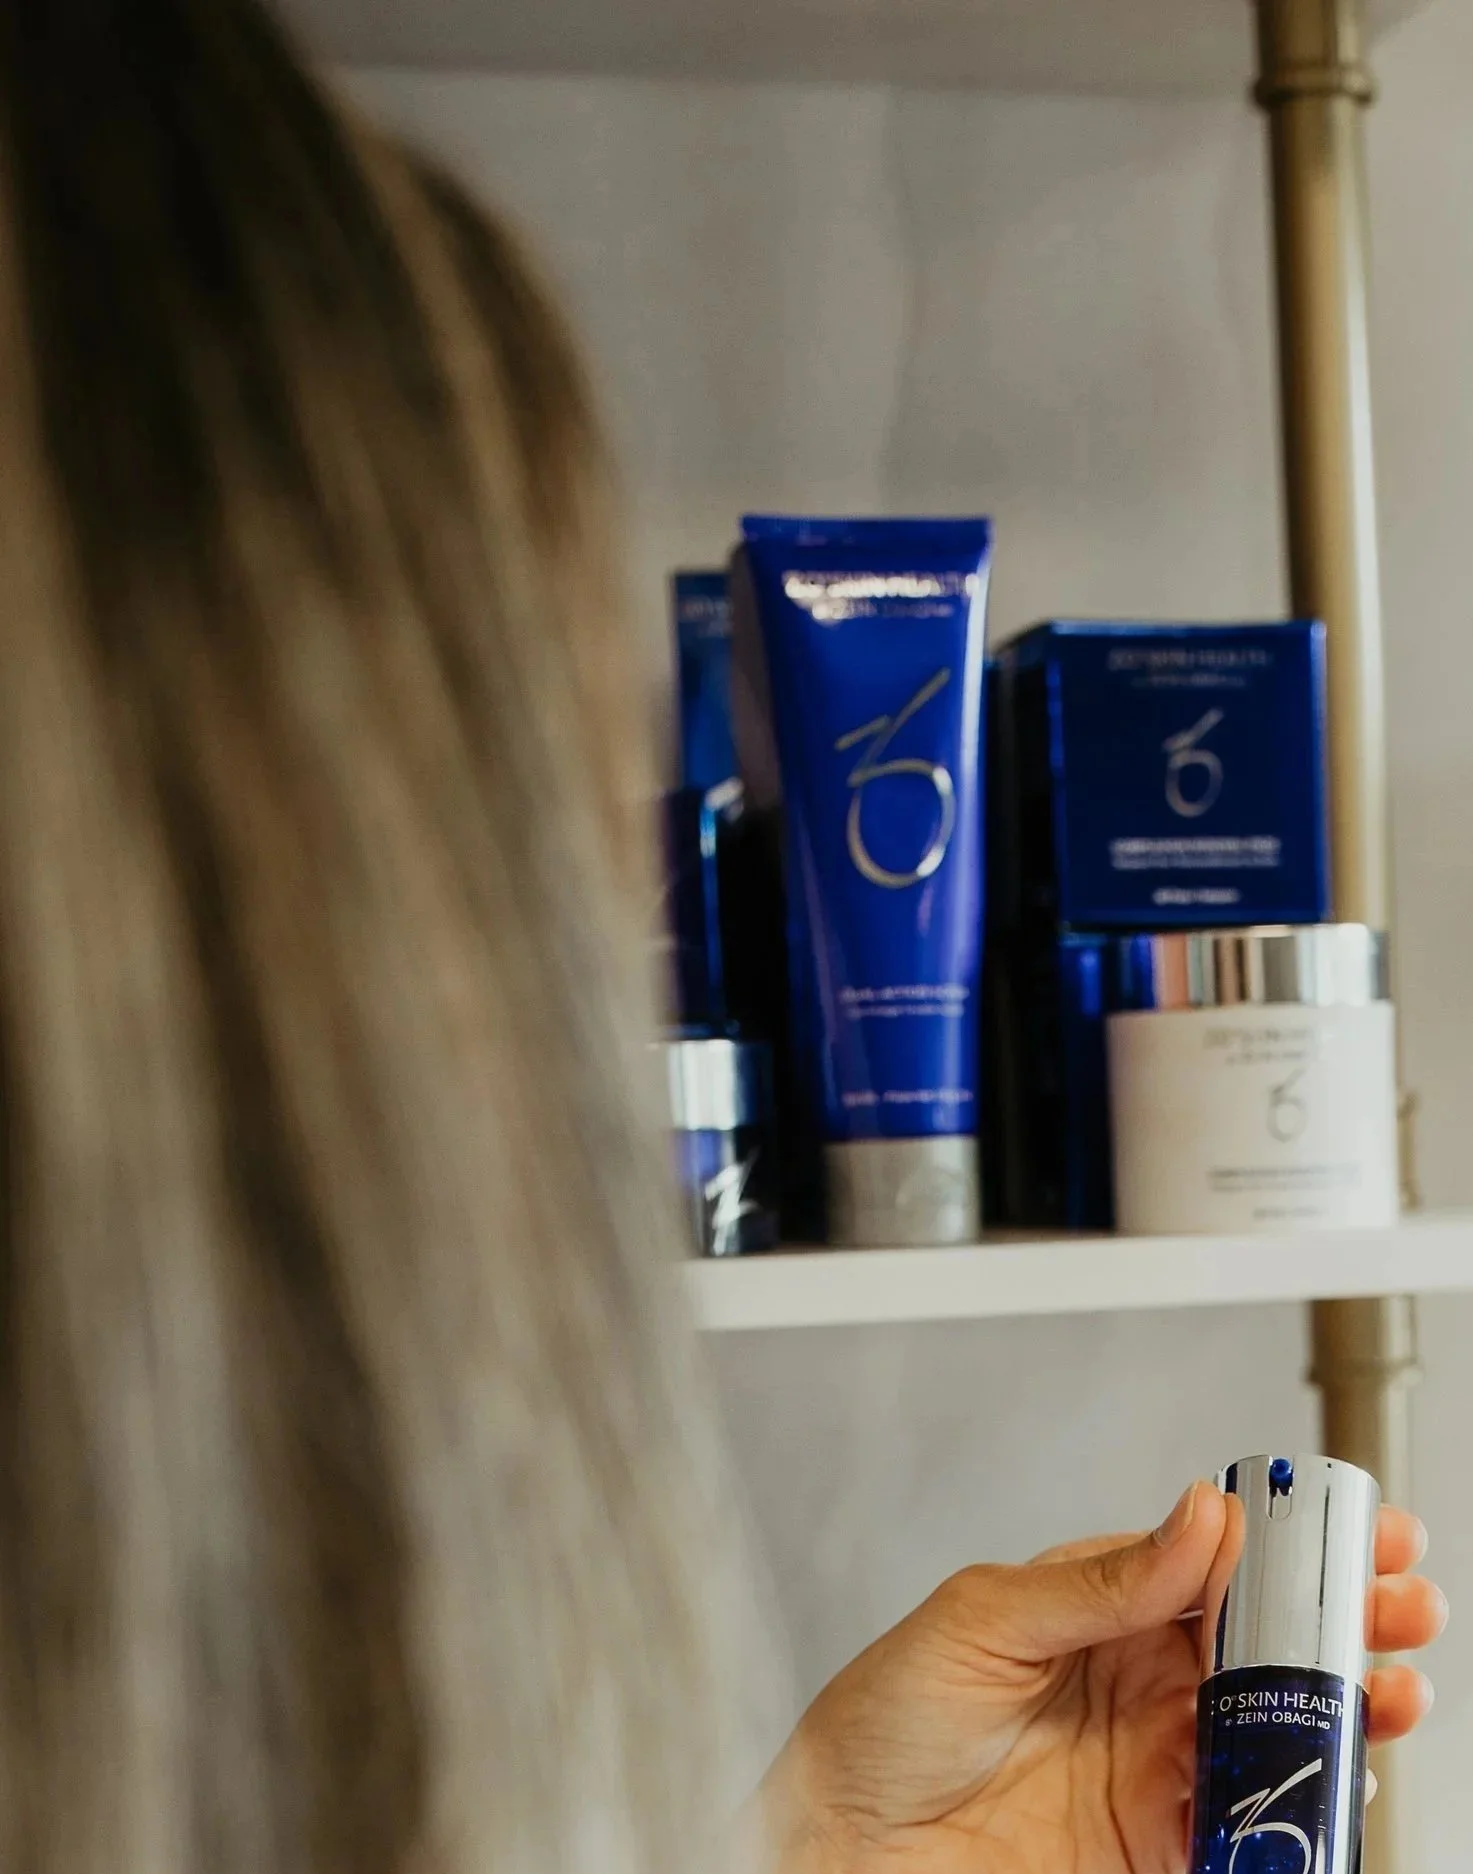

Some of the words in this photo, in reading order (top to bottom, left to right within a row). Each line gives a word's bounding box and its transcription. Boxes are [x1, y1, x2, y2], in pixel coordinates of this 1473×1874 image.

[1237, 1691, 1278, 1709] SKIN
[1284, 1691, 1344, 1718] HEALTH
[1237, 1711, 1268, 1725] ZEIN
[1271, 1711, 1316, 1727] OBAGI
[1317, 1720, 1331, 1730] MD
